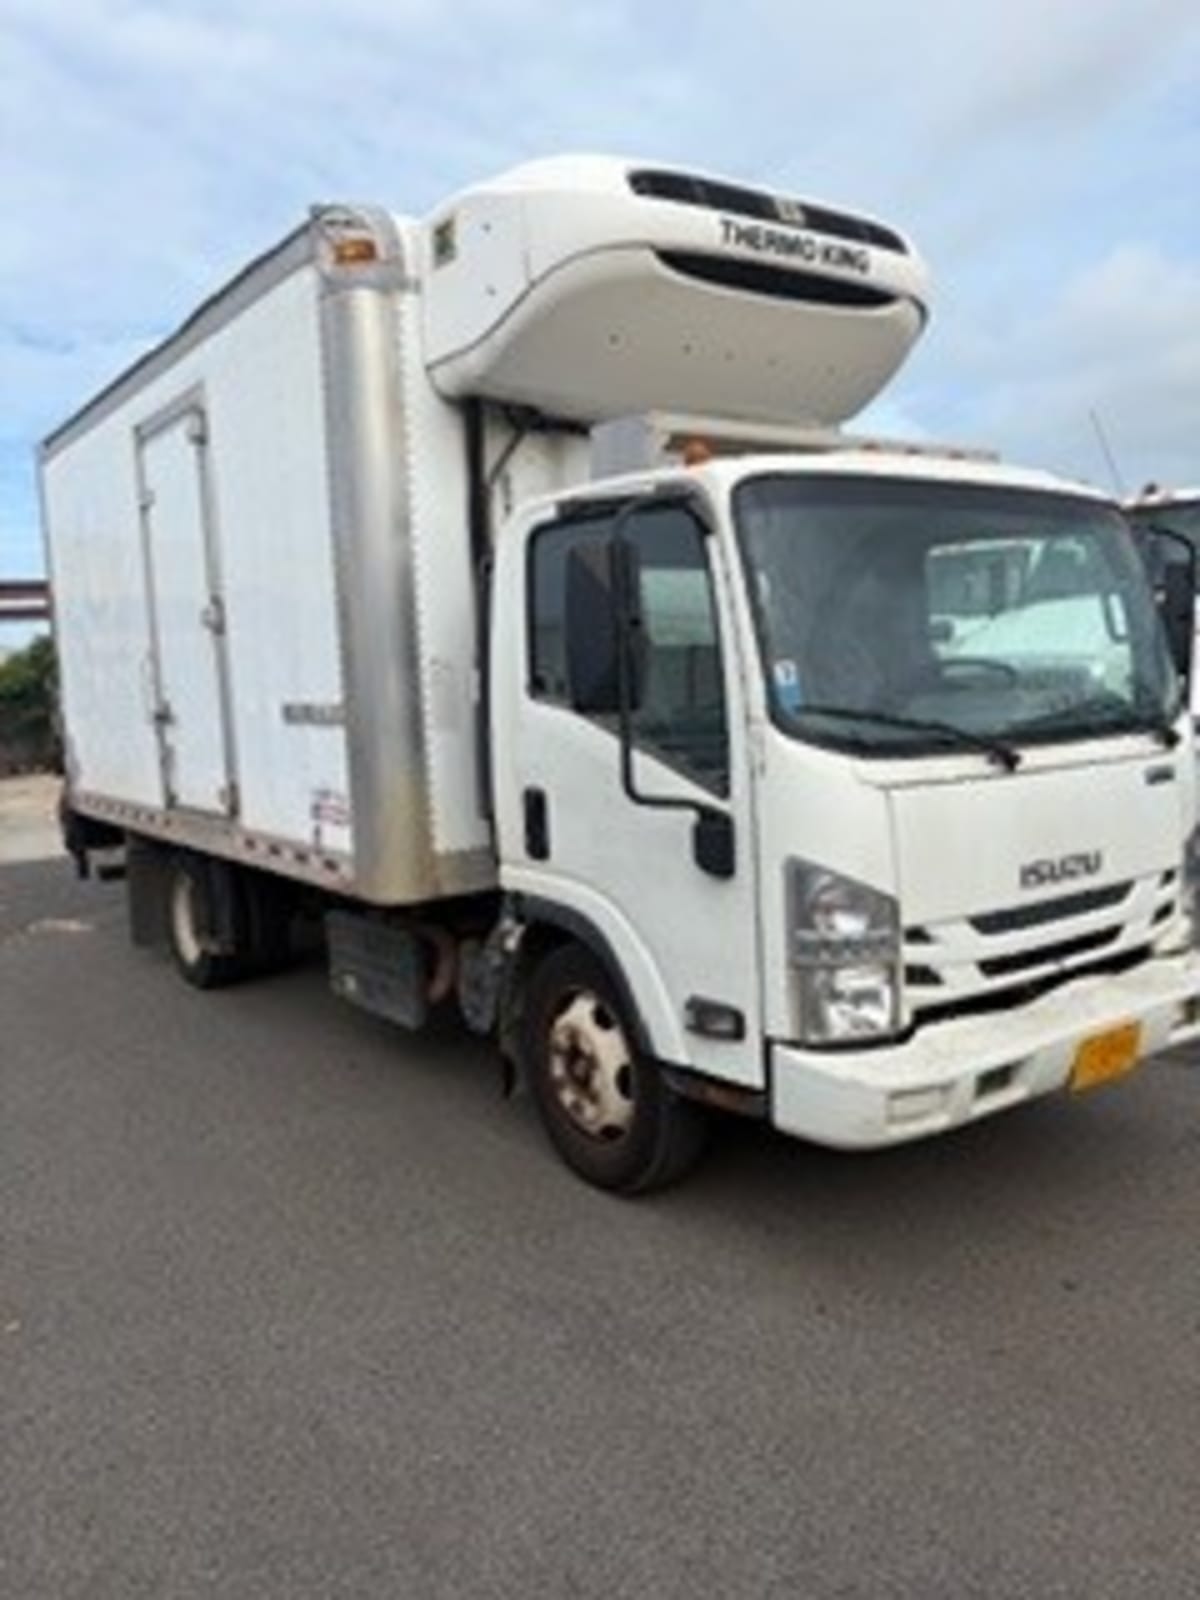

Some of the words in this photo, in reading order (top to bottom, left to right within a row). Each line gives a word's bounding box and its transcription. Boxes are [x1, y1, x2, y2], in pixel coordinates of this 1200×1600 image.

[720, 218, 816, 261] THERMO
[822, 243, 871, 275] KING
[1019, 850, 1102, 890] ISUZU
